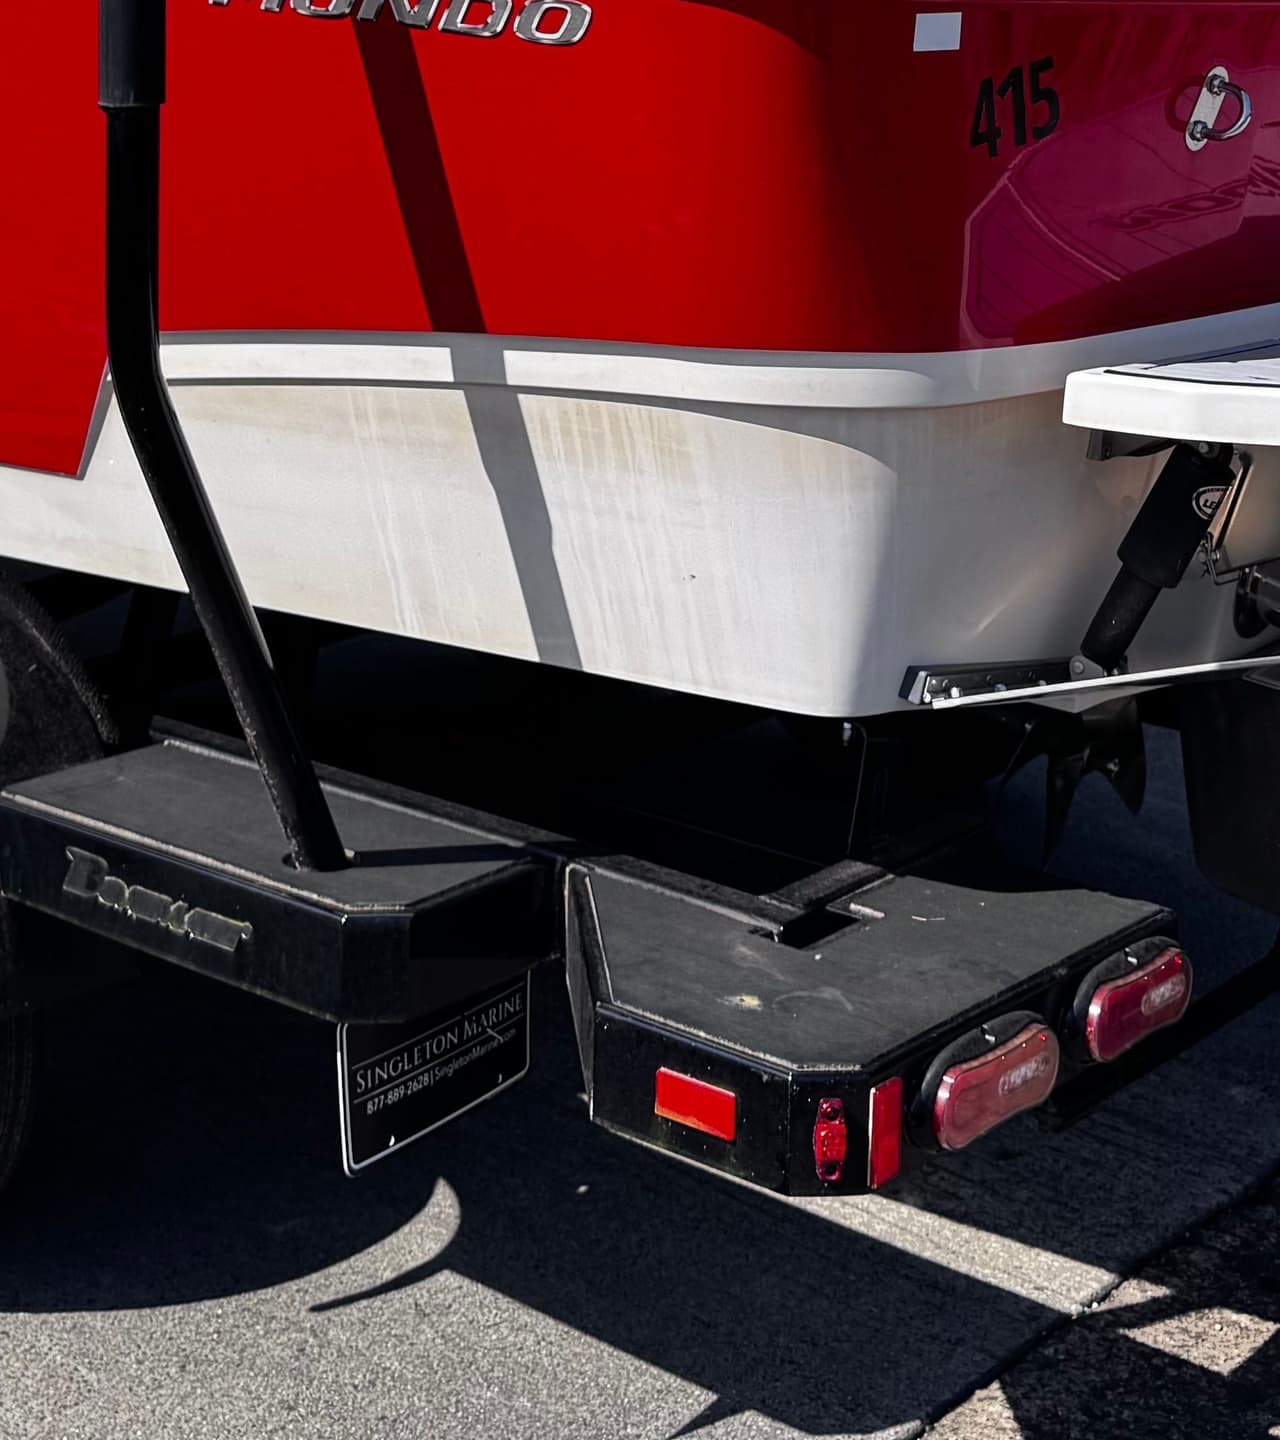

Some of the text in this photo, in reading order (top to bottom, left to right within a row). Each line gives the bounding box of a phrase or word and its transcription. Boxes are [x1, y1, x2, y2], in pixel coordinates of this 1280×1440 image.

[969, 55, 1061, 159] 415
[355, 992, 523, 1094] SINGLETON MARINE
